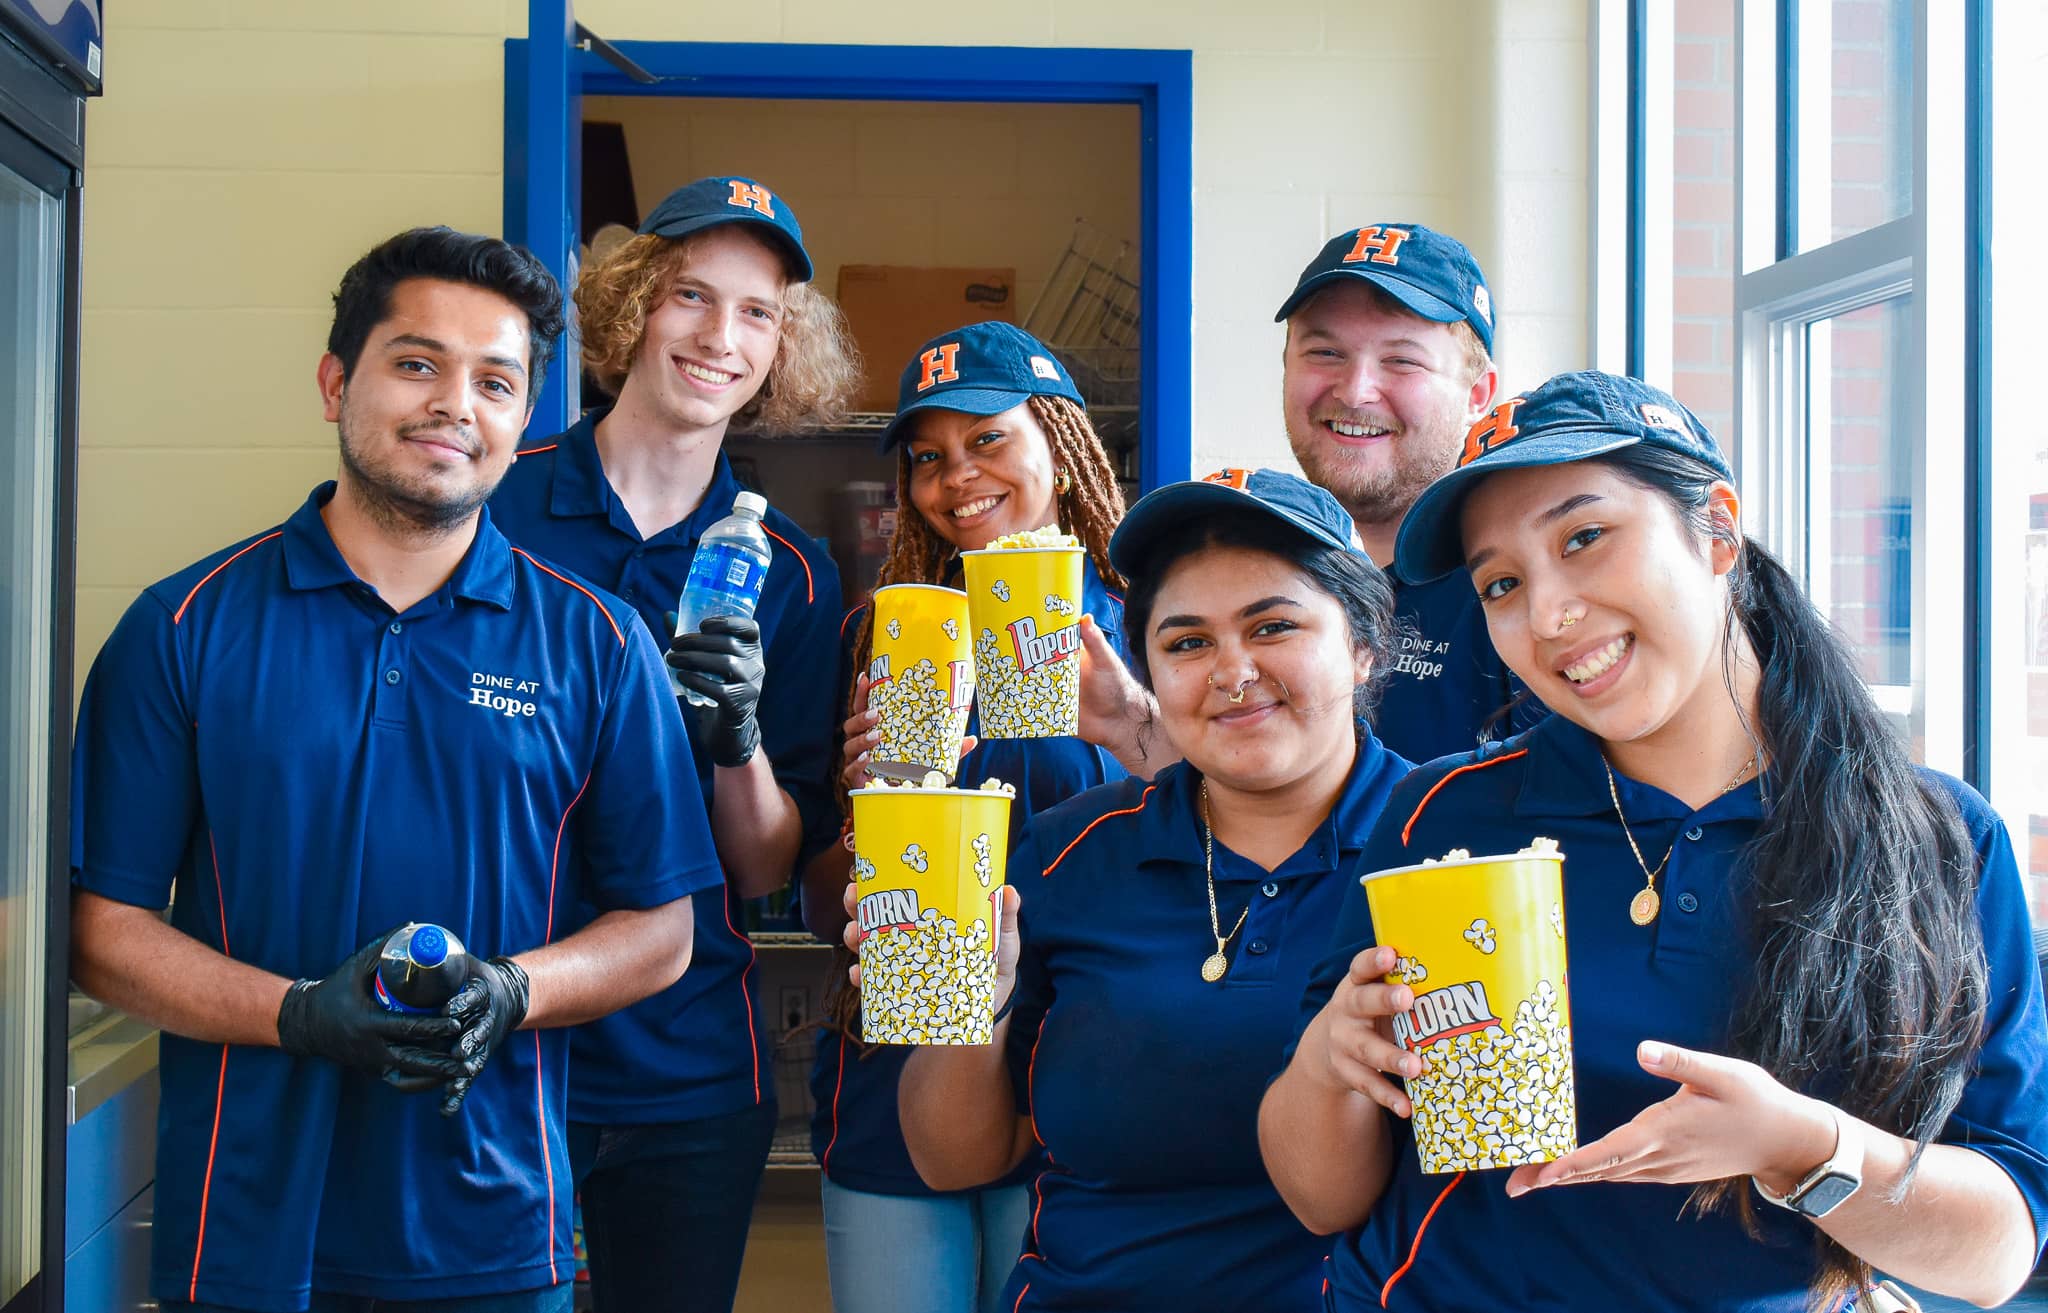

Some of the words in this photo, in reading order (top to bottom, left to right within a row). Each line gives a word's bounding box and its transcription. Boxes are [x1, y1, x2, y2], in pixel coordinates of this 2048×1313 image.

[728, 180, 775, 219] H
[1342, 226, 1409, 266] H
[917, 342, 960, 392] H
[1460, 398, 1527, 467] H
[1401, 637, 1433, 652] DINE
[1433, 641, 1450, 655] AT
[472, 672, 515, 690] DINE
[516, 680, 541, 695] AT
[1393, 654, 1443, 680] Hope
[468, 687, 537, 718] Hope
[858, 889, 920, 932] CORN
